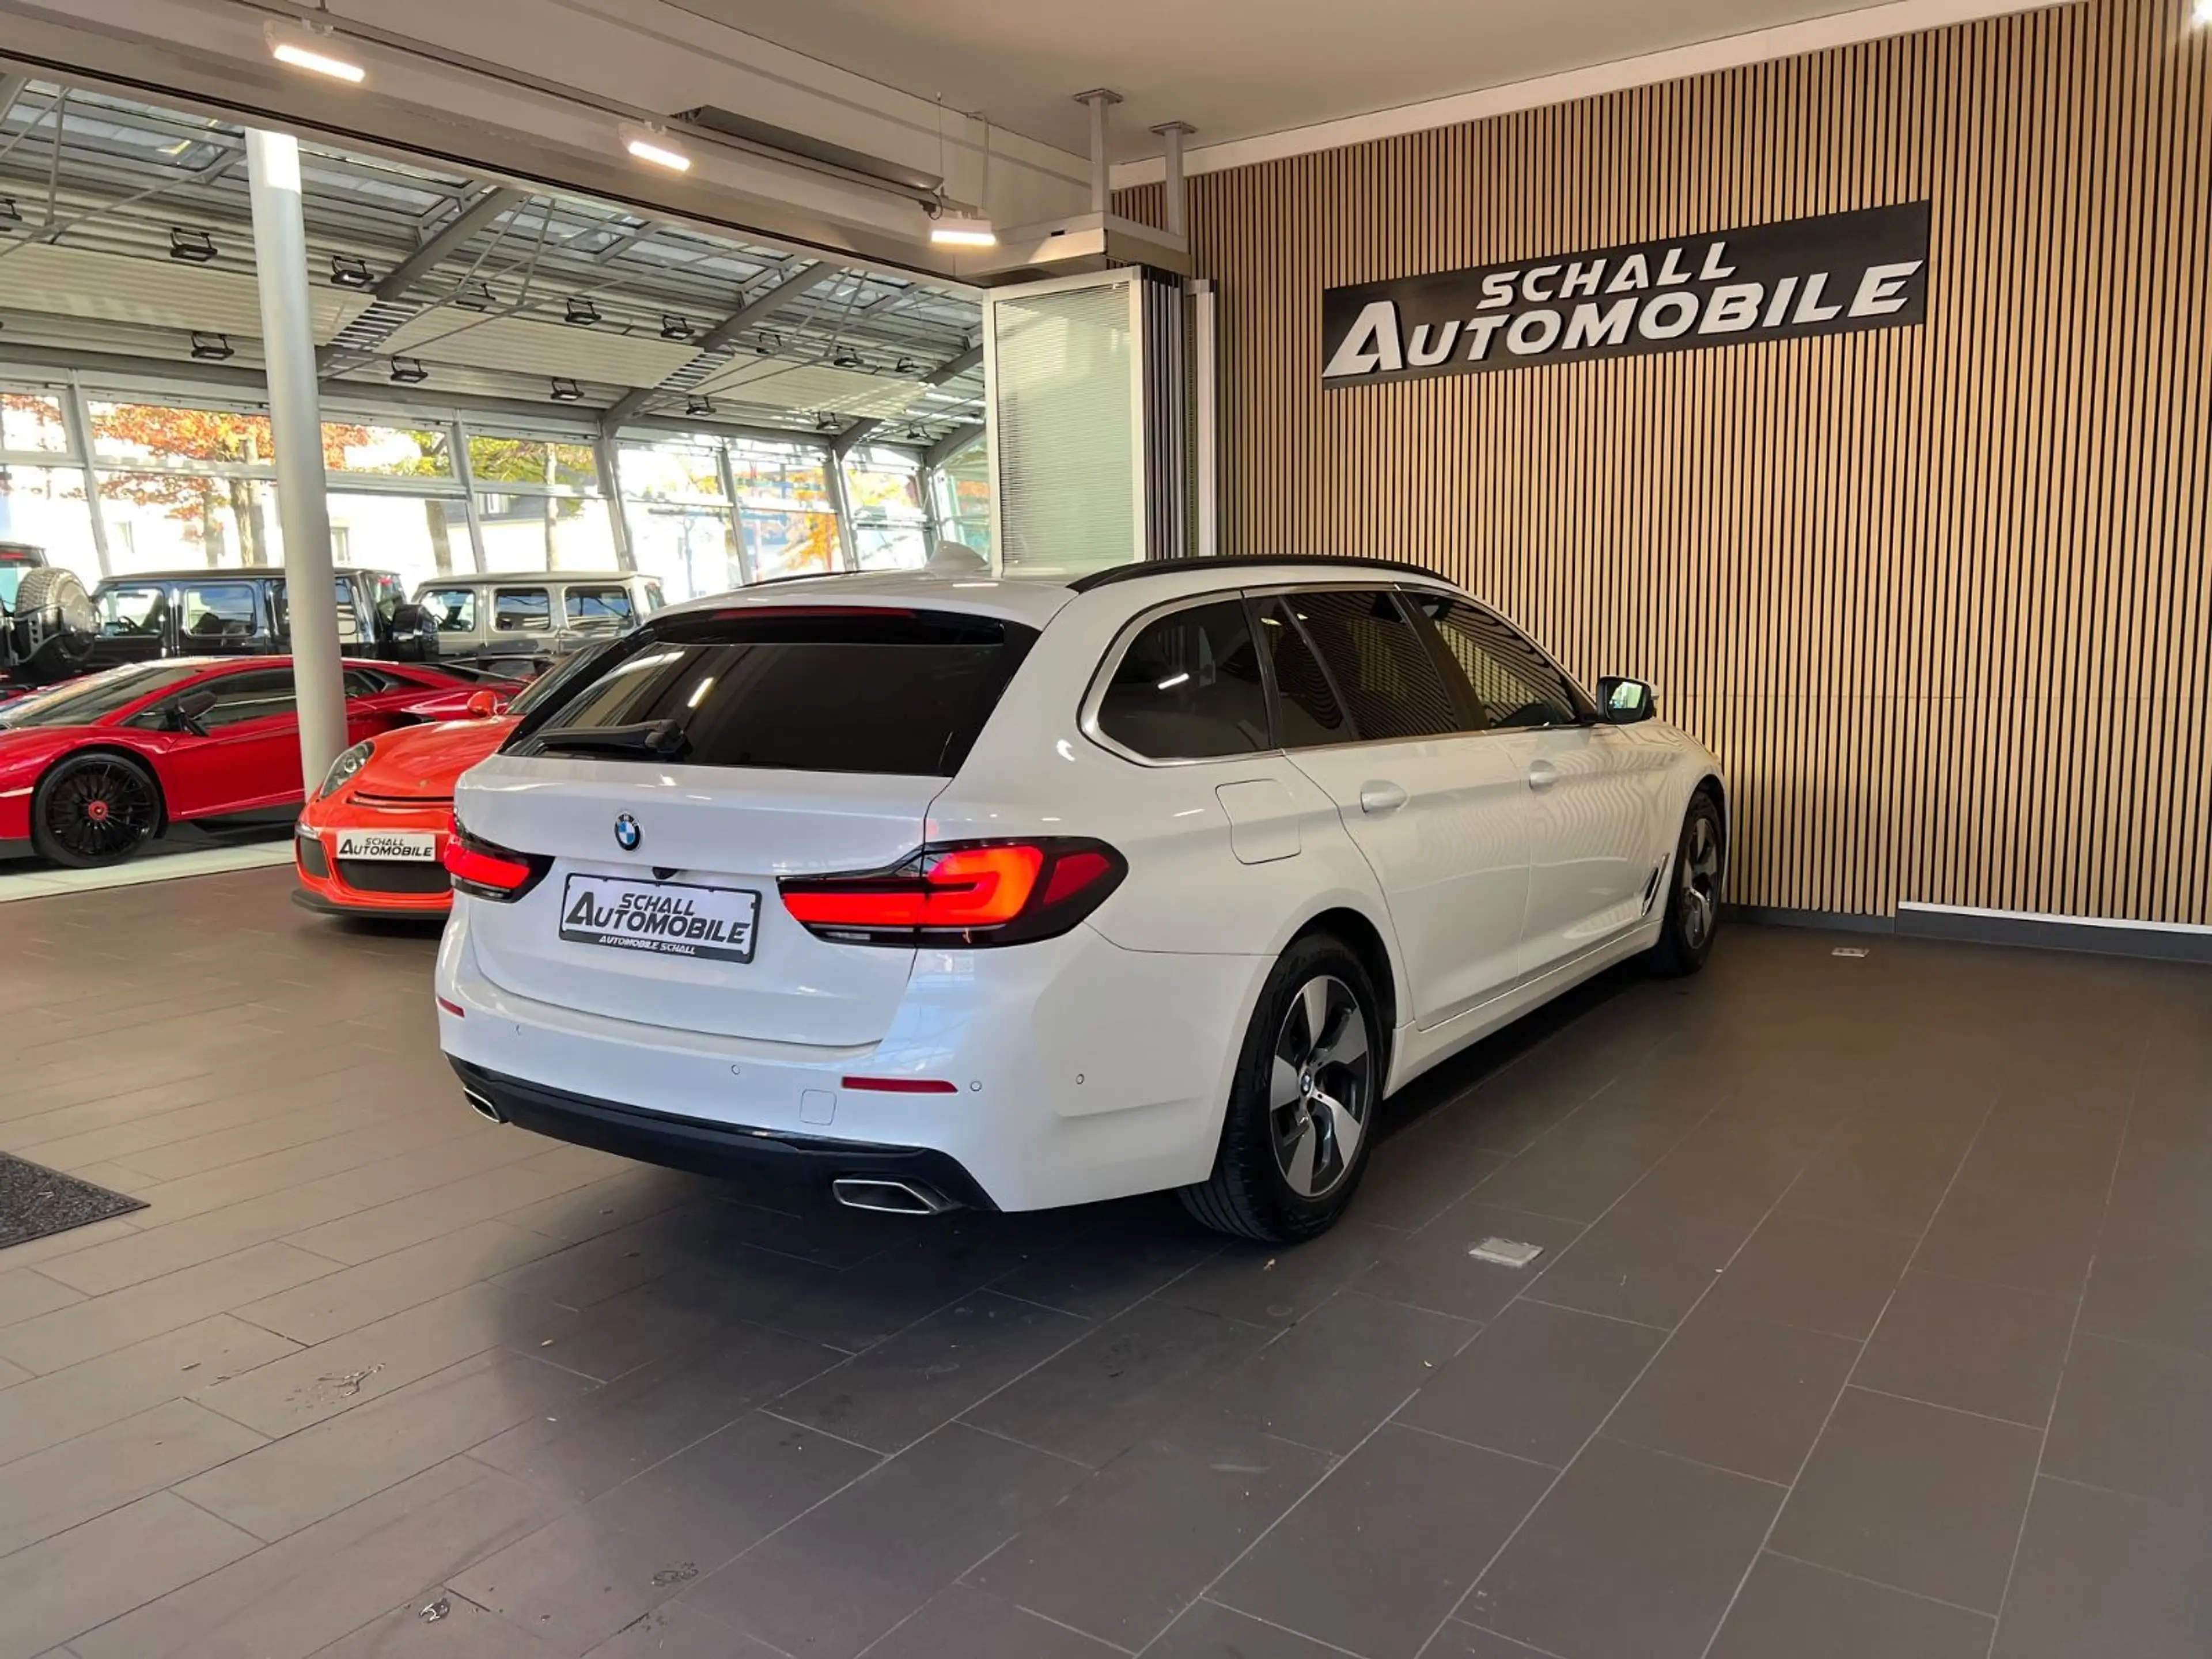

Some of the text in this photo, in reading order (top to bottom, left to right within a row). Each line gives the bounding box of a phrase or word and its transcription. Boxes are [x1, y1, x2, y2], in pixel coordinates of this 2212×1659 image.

[1475, 241, 1736, 309] SCHALL
[1321, 259, 1924, 377] AUTOMOBILE
[339, 839, 433, 857] AUTOMOBILE
[365, 838, 404, 846] SCHALL
[619, 893, 695, 916] SCHALL
[565, 892, 750, 944] AUTOMOBILE
[599, 935, 695, 955] AUTOMOBILE SCHALL
